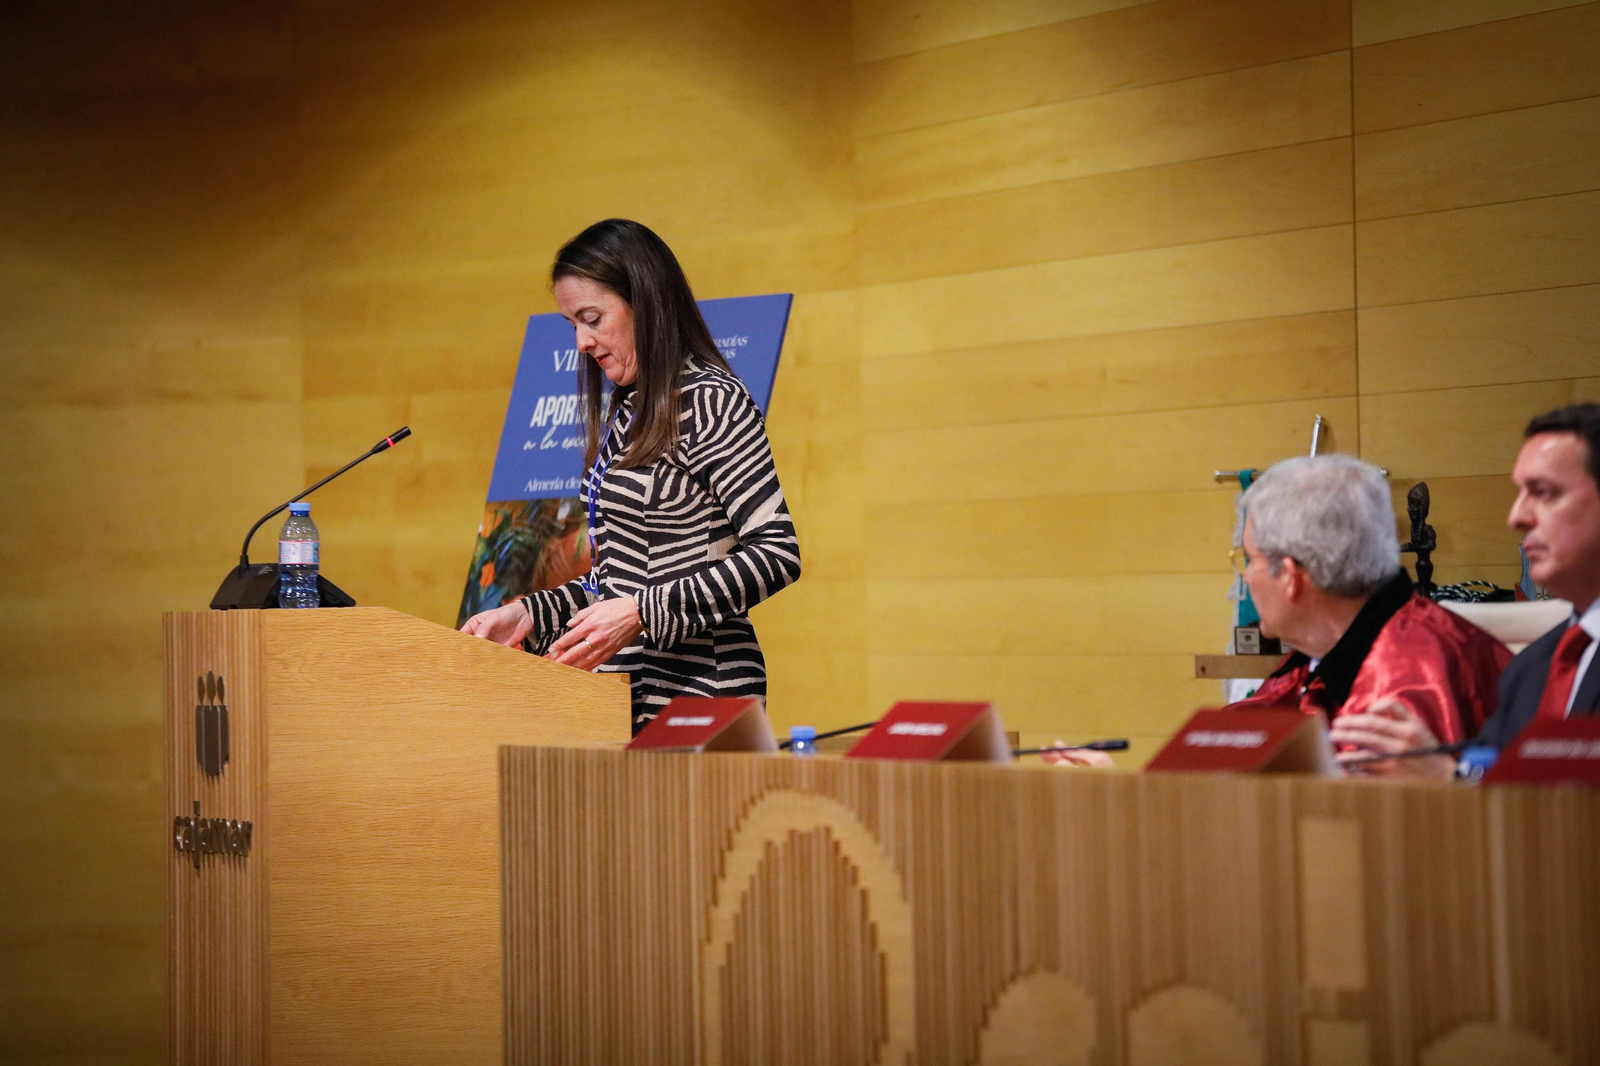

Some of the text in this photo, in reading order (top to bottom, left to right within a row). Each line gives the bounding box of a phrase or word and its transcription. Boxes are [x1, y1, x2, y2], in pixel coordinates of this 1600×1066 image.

[523, 440, 536, 451] a
[540, 426, 558, 451] la
[525, 478, 564, 491] Almería
